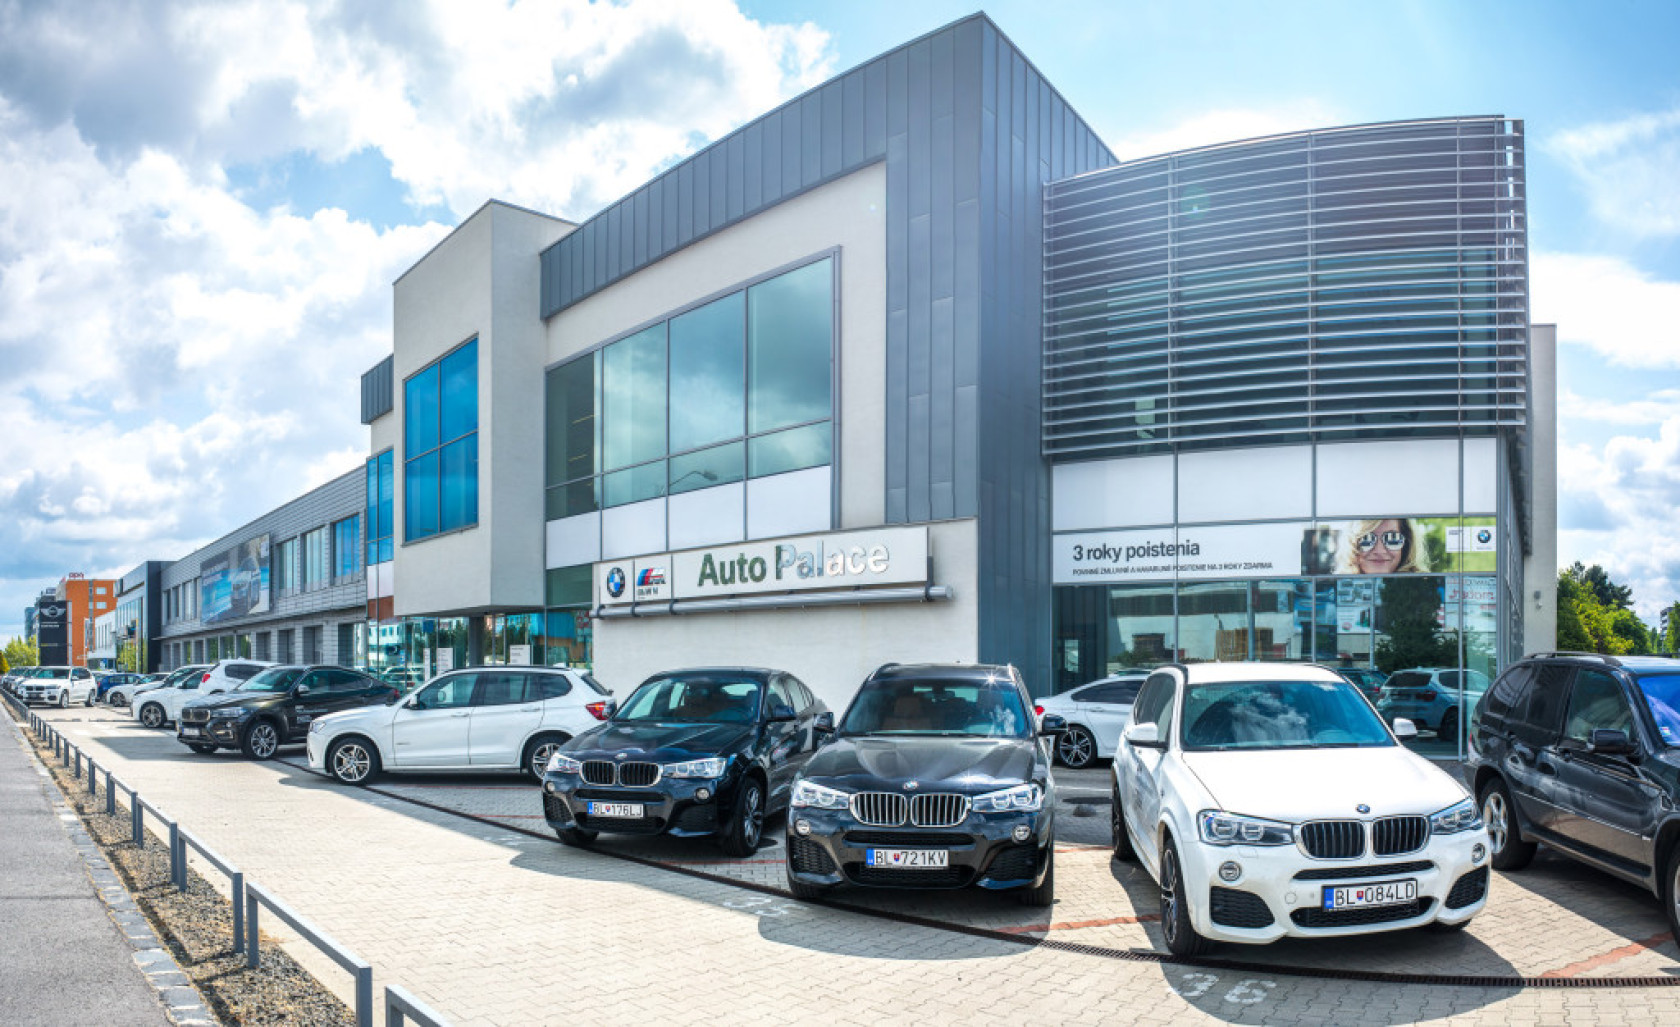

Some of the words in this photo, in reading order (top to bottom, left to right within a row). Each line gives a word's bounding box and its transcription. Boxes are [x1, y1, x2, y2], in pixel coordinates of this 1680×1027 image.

[697, 553, 766, 587] Auto
[775, 540, 890, 581] Palace
[1073, 545, 1083, 561] 3
[1087, 543, 1122, 563] roky
[1126, 540, 1200, 561] poistenia
[900, 851, 946, 865] 721KV
[1335, 889, 1356, 906] BL
[1365, 882, 1415, 903] 084LD
[1181, 973, 1277, 1004] 36
